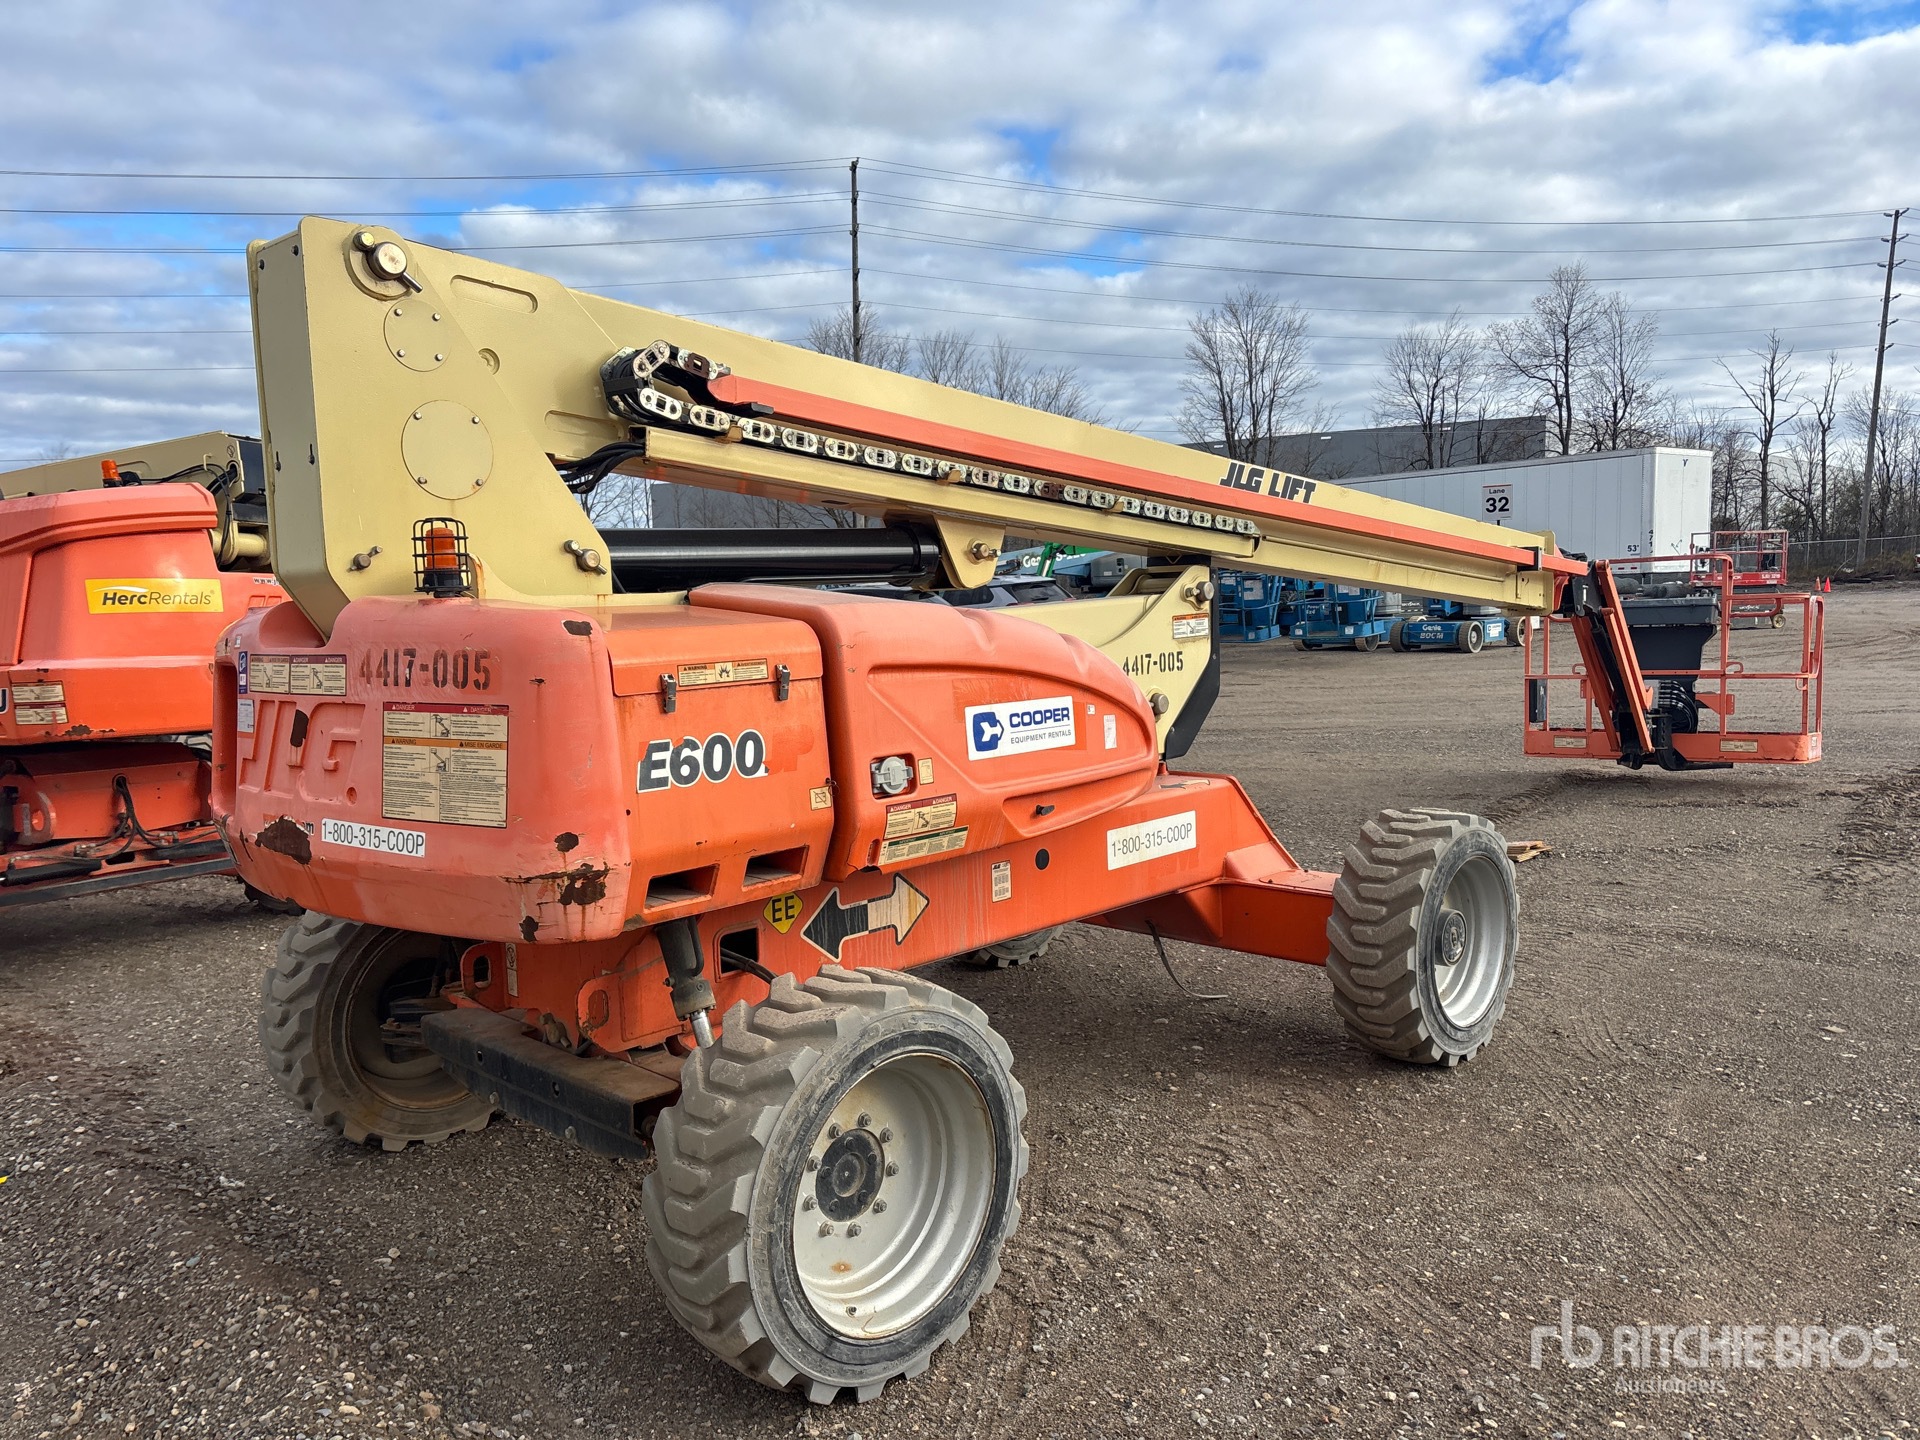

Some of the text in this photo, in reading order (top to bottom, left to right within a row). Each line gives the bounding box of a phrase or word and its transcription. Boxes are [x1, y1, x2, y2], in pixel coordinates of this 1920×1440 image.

[1220, 462, 1316, 504] JLG LIFT
[1485, 496, 1510, 513] 32
[359, 648, 491, 690] 4417-005
[1122, 651, 1184, 677] 4417-005
[1009, 707, 1070, 728] COOPER
[1010, 729, 1072, 744] EQUIPMENT RENTALS
[893, 796, 953, 812] DANGER DANGER
[323, 821, 424, 854] 1-800-315-COOP
[1111, 823, 1192, 857] 1-800-315-COOP
[772, 896, 795, 923] EE
